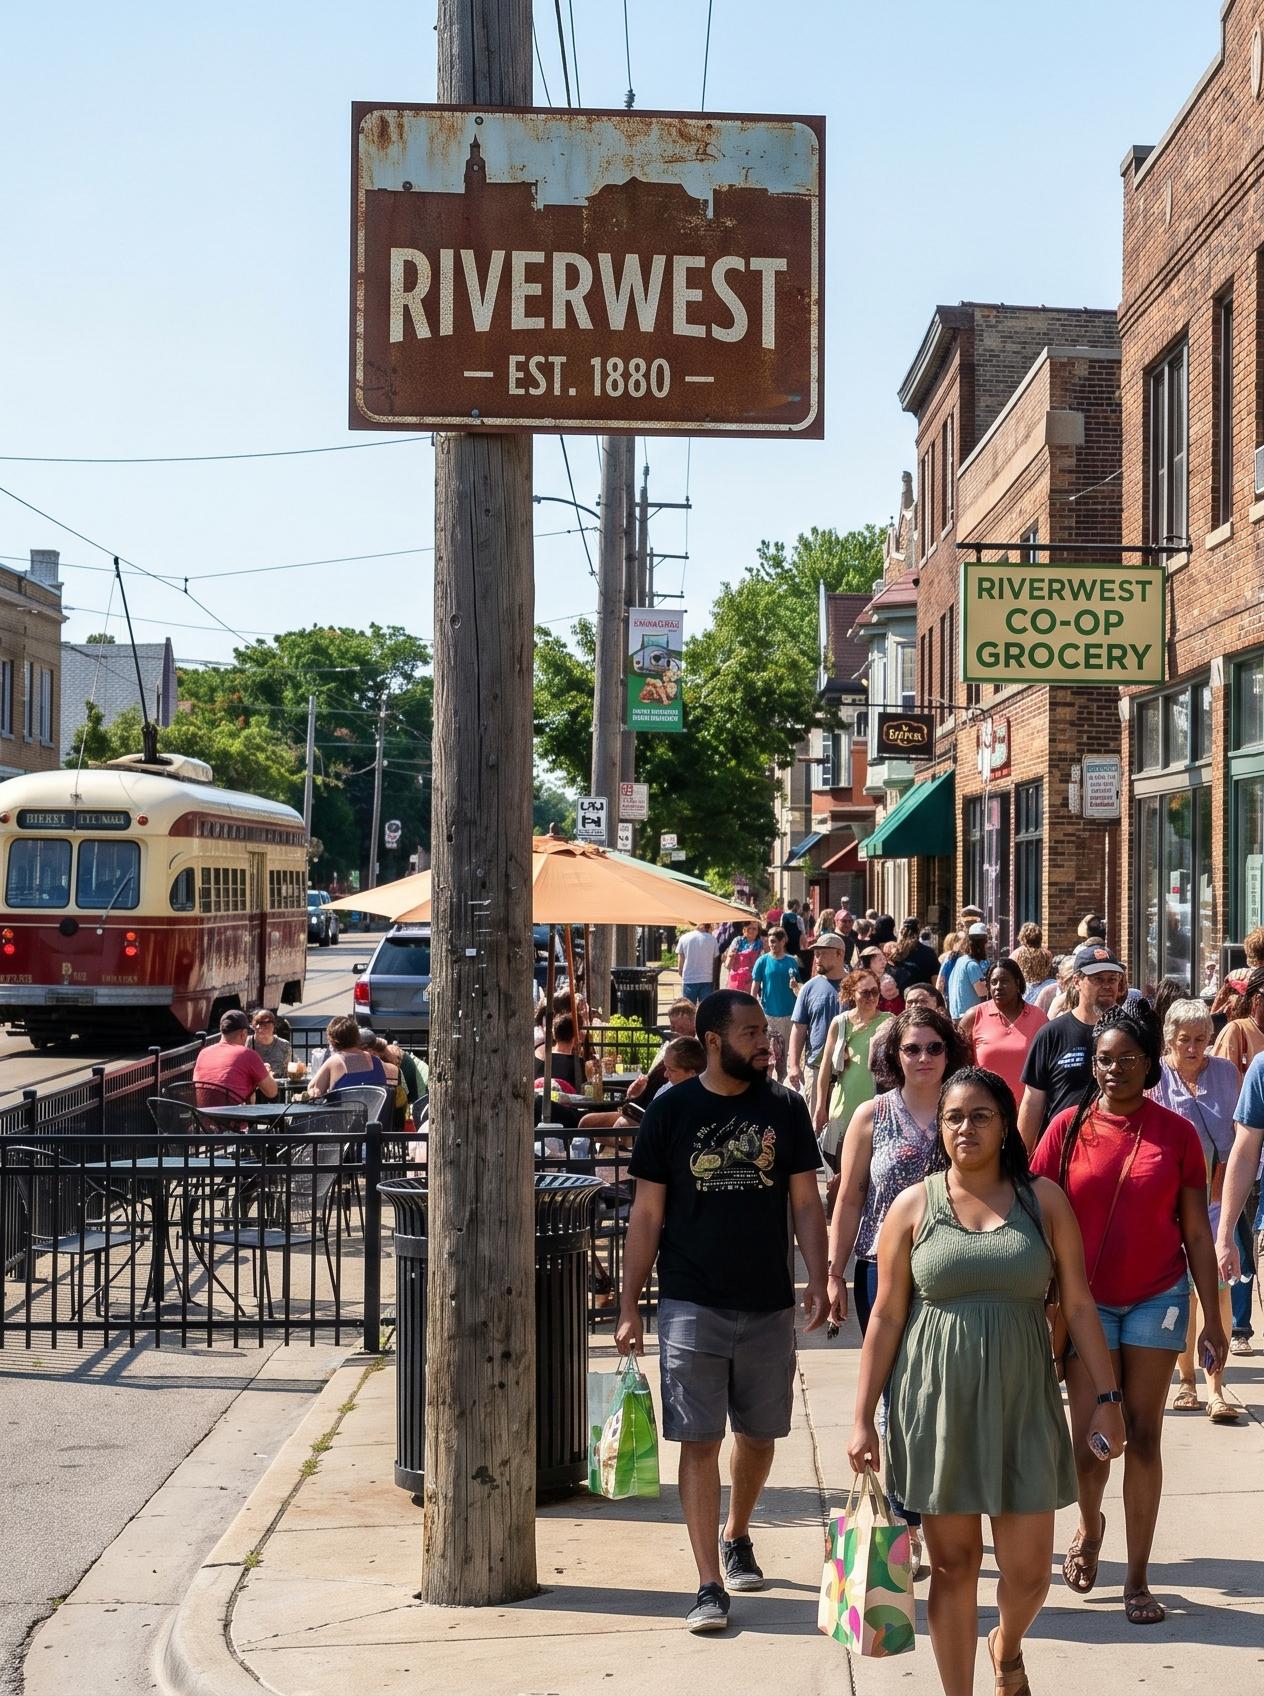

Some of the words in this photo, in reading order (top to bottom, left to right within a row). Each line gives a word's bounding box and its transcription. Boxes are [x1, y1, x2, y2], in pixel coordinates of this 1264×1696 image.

[389, 247, 788, 350] RIVERWEST
[508, 355, 577, 397] EST.
[591, 357, 671, 399] 1880
[977, 576, 1153, 602] RIVERWEST
[1005, 607, 1125, 636] CO-OP
[975, 641, 1153, 670] GROCERY
